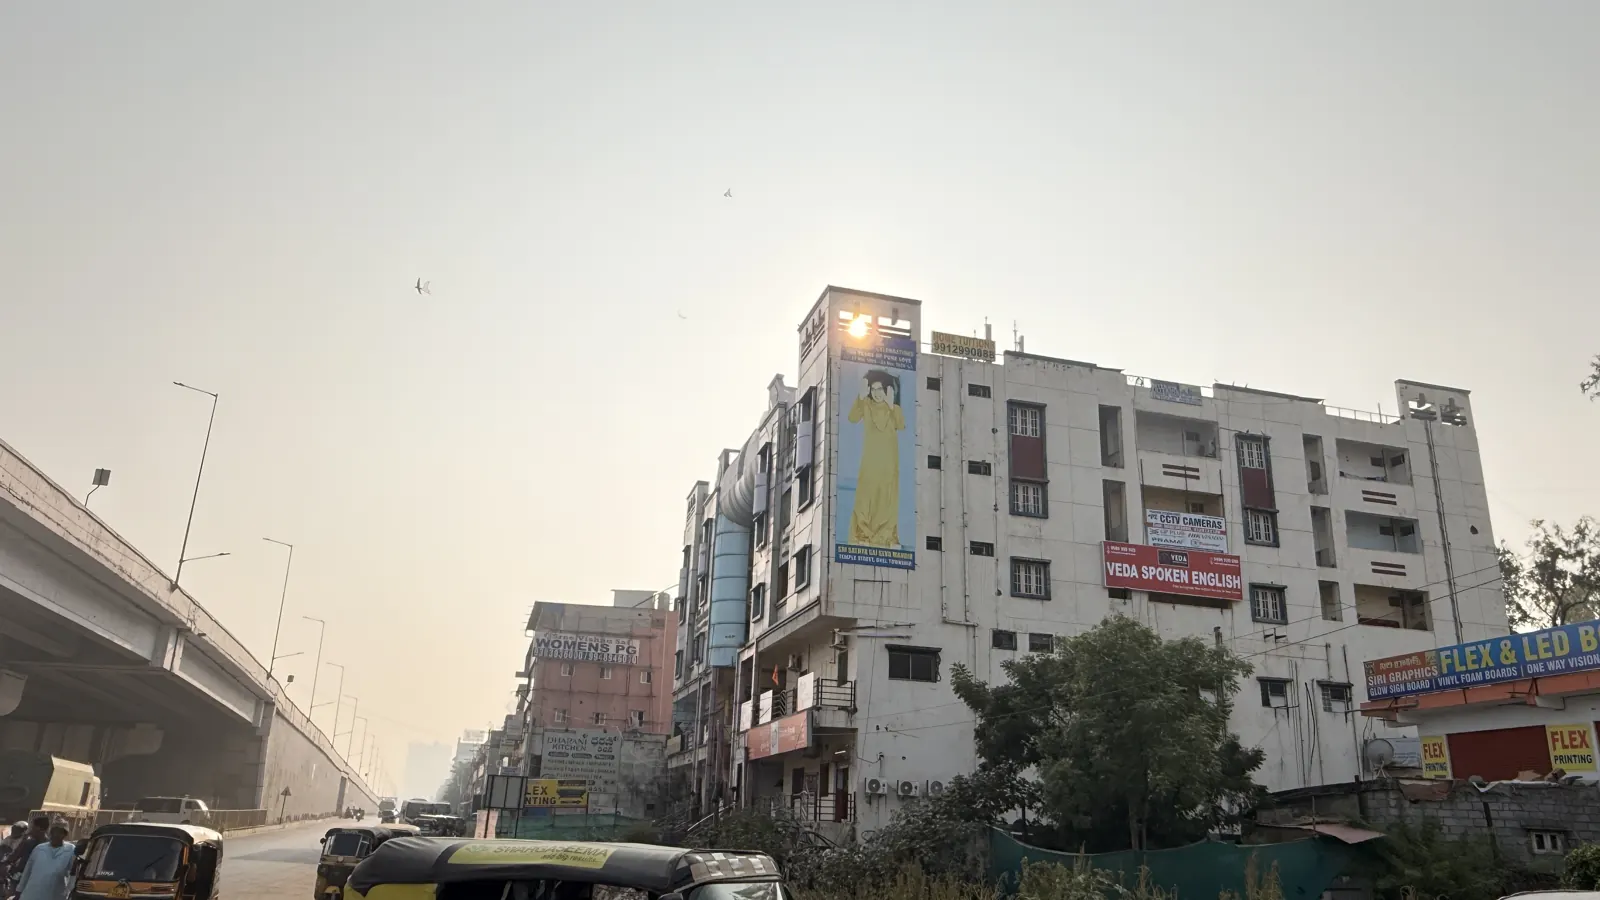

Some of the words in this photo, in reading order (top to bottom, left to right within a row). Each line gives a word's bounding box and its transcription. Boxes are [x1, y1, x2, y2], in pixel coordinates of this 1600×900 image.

[1160, 514, 1180, 525] CCTV
[1182, 517, 1223, 530] CAMERAS
[1170, 553, 1188, 562] VEDA
[1106, 562, 1138, 578] VEDA
[1141, 566, 1188, 584] SPOKEN
[1192, 571, 1241, 589] ENGLISH
[536, 638, 610, 653] WOMENS
[615, 644, 637, 655] PG
[1439, 642, 1494, 674] FLEX
[1500, 640, 1518, 664] &
[1522, 630, 1570, 662] LED
[1578, 624, 1600, 652] B
[1368, 674, 1386, 686] SIRI
[1388, 666, 1438, 683] GRAPHICS
[1370, 686, 1388, 696] GLOW
[1390, 682, 1406, 694] SIGN
[1406, 680, 1430, 691] BOARD
[1438, 676, 1458, 687] VINYL
[1460, 672, 1483, 684] FOAM
[1485, 667, 1518, 680] BOARDS
[1527, 662, 1545, 674] ONE
[1546, 659, 1566, 672] WAY
[1568, 654, 1600, 668] VISION
[546, 736, 588, 746] DHARANI
[552, 743, 587, 752] KITCHEN
[1550, 729, 1590, 752] FLEX
[1423, 742, 1444, 760] FLEX
[1425, 762, 1448, 772] PRINTING
[1554, 754, 1592, 765] PRINTING
[525, 786, 548, 796] LEX
[524, 796, 556, 805] NTING
